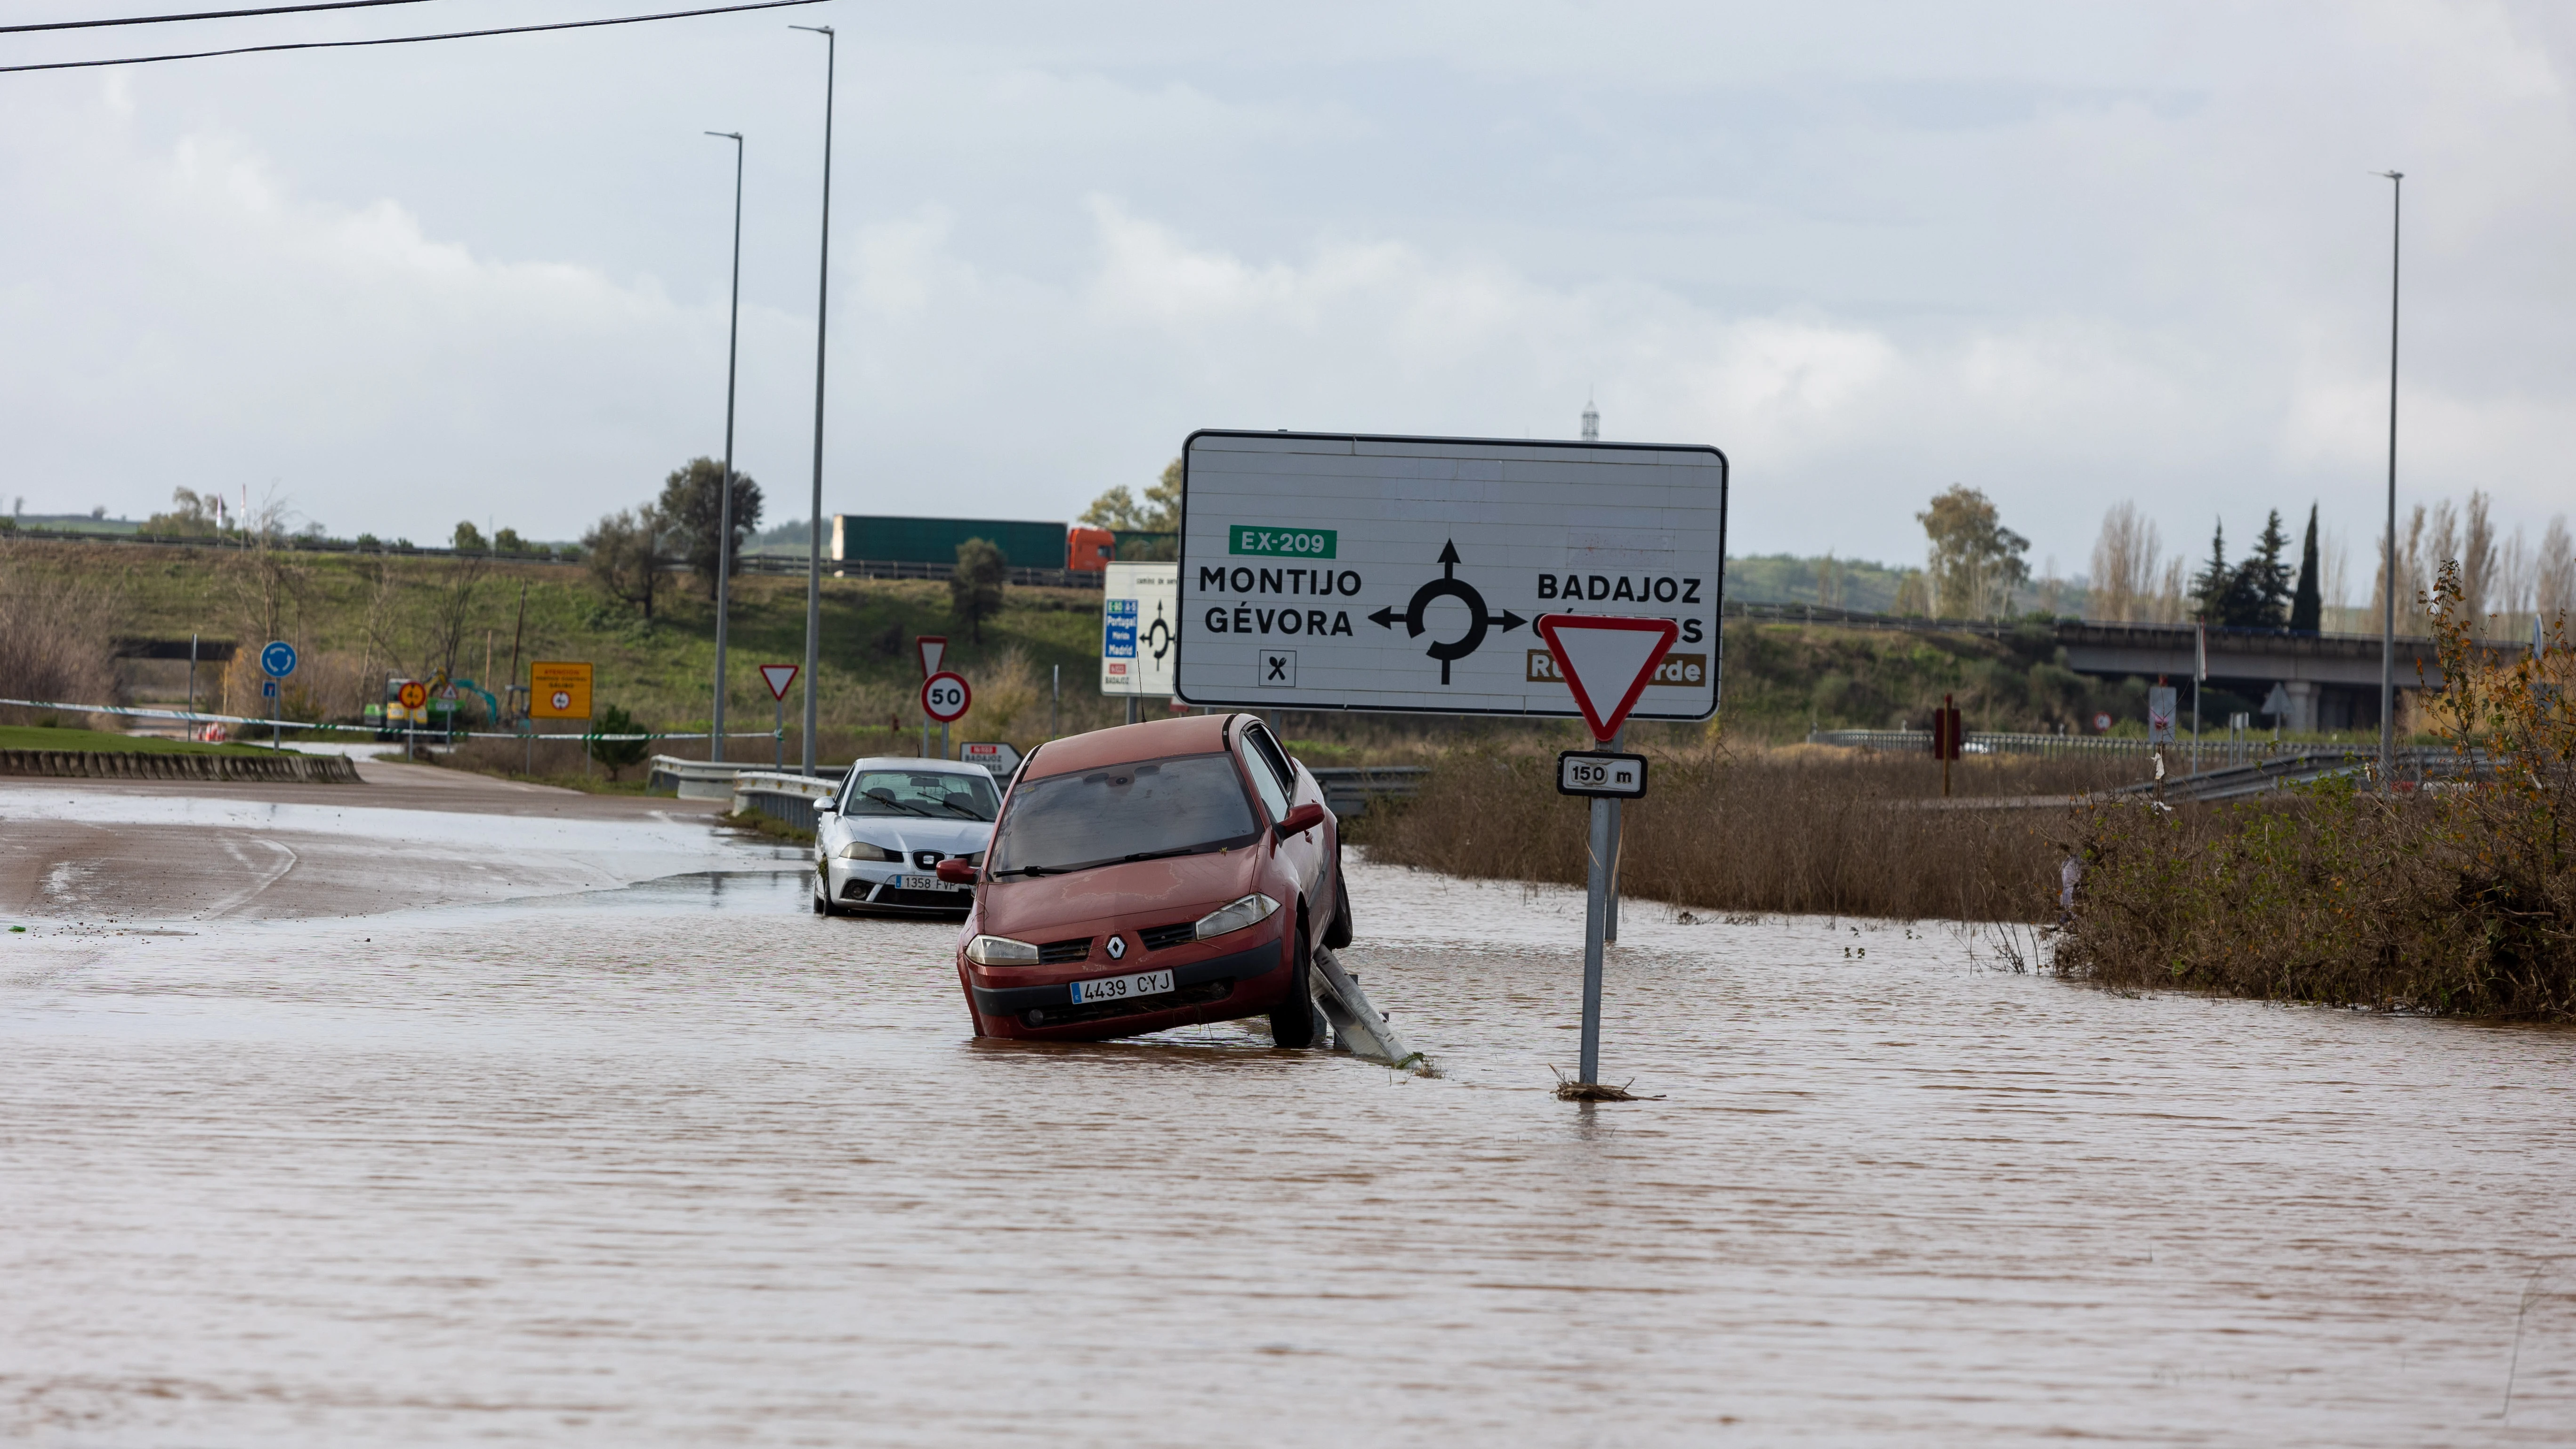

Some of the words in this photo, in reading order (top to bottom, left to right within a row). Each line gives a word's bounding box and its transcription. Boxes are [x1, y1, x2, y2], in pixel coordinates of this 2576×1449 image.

[1242, 531, 1324, 553] EX-209
[1200, 566, 1361, 596] MONTIJO
[1538, 574, 1701, 604] BADAJOZ
[1107, 615, 1136, 629] Portugal
[1205, 602, 1353, 636] GÉVORA
[1109, 644, 1133, 656] Madrid
[932, 689, 960, 705] 50
[965, 754, 1002, 762] BADAJOZ
[1573, 766, 1605, 781] 150
[1617, 772, 1632, 782] m
[906, 877, 931, 888] 1358
[1085, 980, 1127, 999] 4439
[1137, 973, 1169, 992] CYJ
